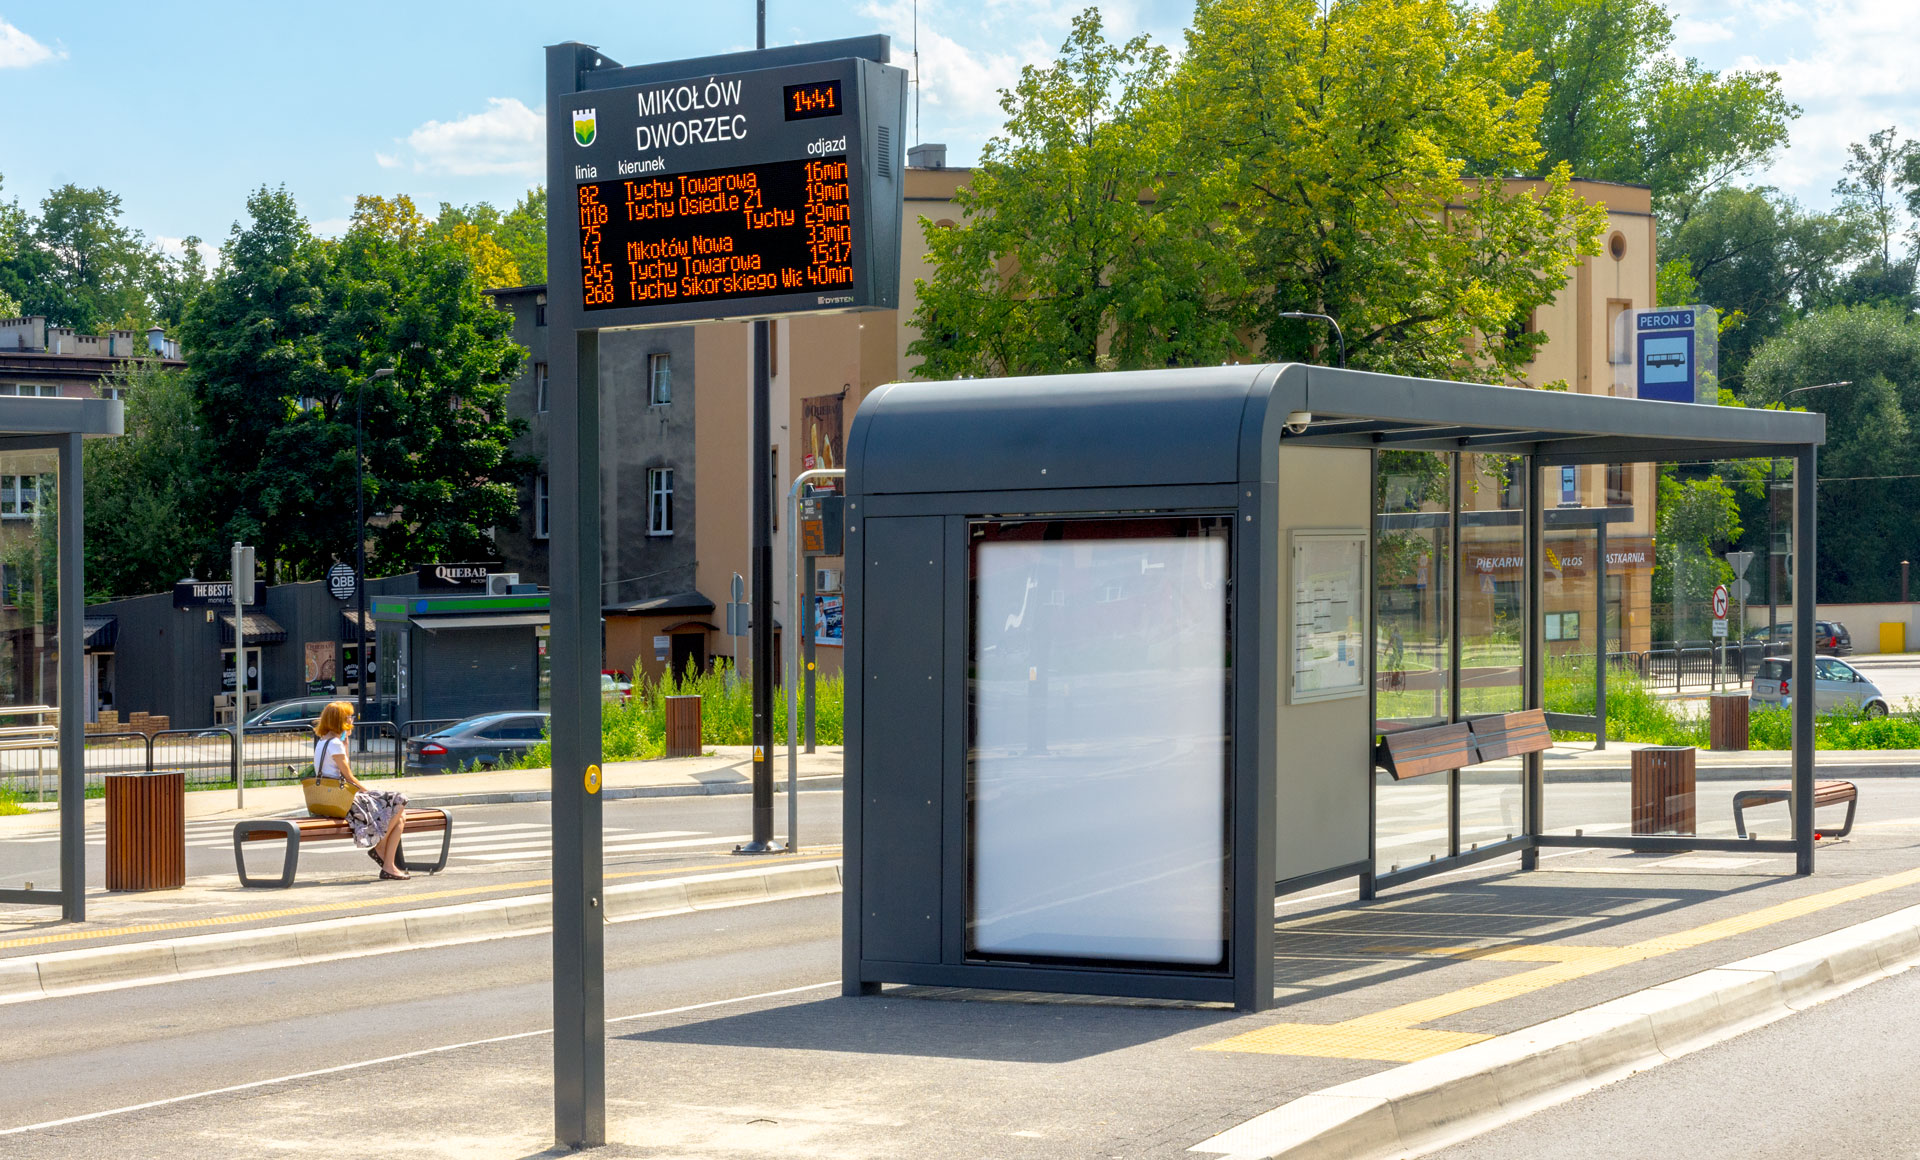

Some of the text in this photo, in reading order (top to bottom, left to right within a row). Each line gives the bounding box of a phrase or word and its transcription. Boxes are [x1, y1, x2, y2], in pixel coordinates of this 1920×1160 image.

[638, 77, 742, 117] MIKOŁÓW
[792, 87, 836, 112] 14:41
[636, 114, 747, 151] DWORZEC
[575, 136, 846, 180] linia kierunek odjazd
[579, 161, 848, 205] 82 Tychy Towarowa 16min
[581, 182, 849, 225] M18 Tychy Osiedle Z1 19min
[582, 203, 850, 245] 75 Tychy 29min
[583, 224, 851, 264] 41 Mikołów Nowa 33min
[584, 242, 851, 285] 245 Tychy Towarowa 15:17
[585, 283, 614, 304] 268
[630, 280, 677, 300] Tychy
[682, 272, 777, 296] Sikorskiego
[807, 264, 853, 285] 40min
[1640, 314, 1691, 327] PERON 3
[435, 566, 487, 584] QUEBAB
[1476, 552, 1645, 568] PIEKARNI KŁOS ASTKARNIA
[193, 585, 207, 597] THE
[208, 584, 227, 597] BEST
[331, 576, 355, 588] QBB
